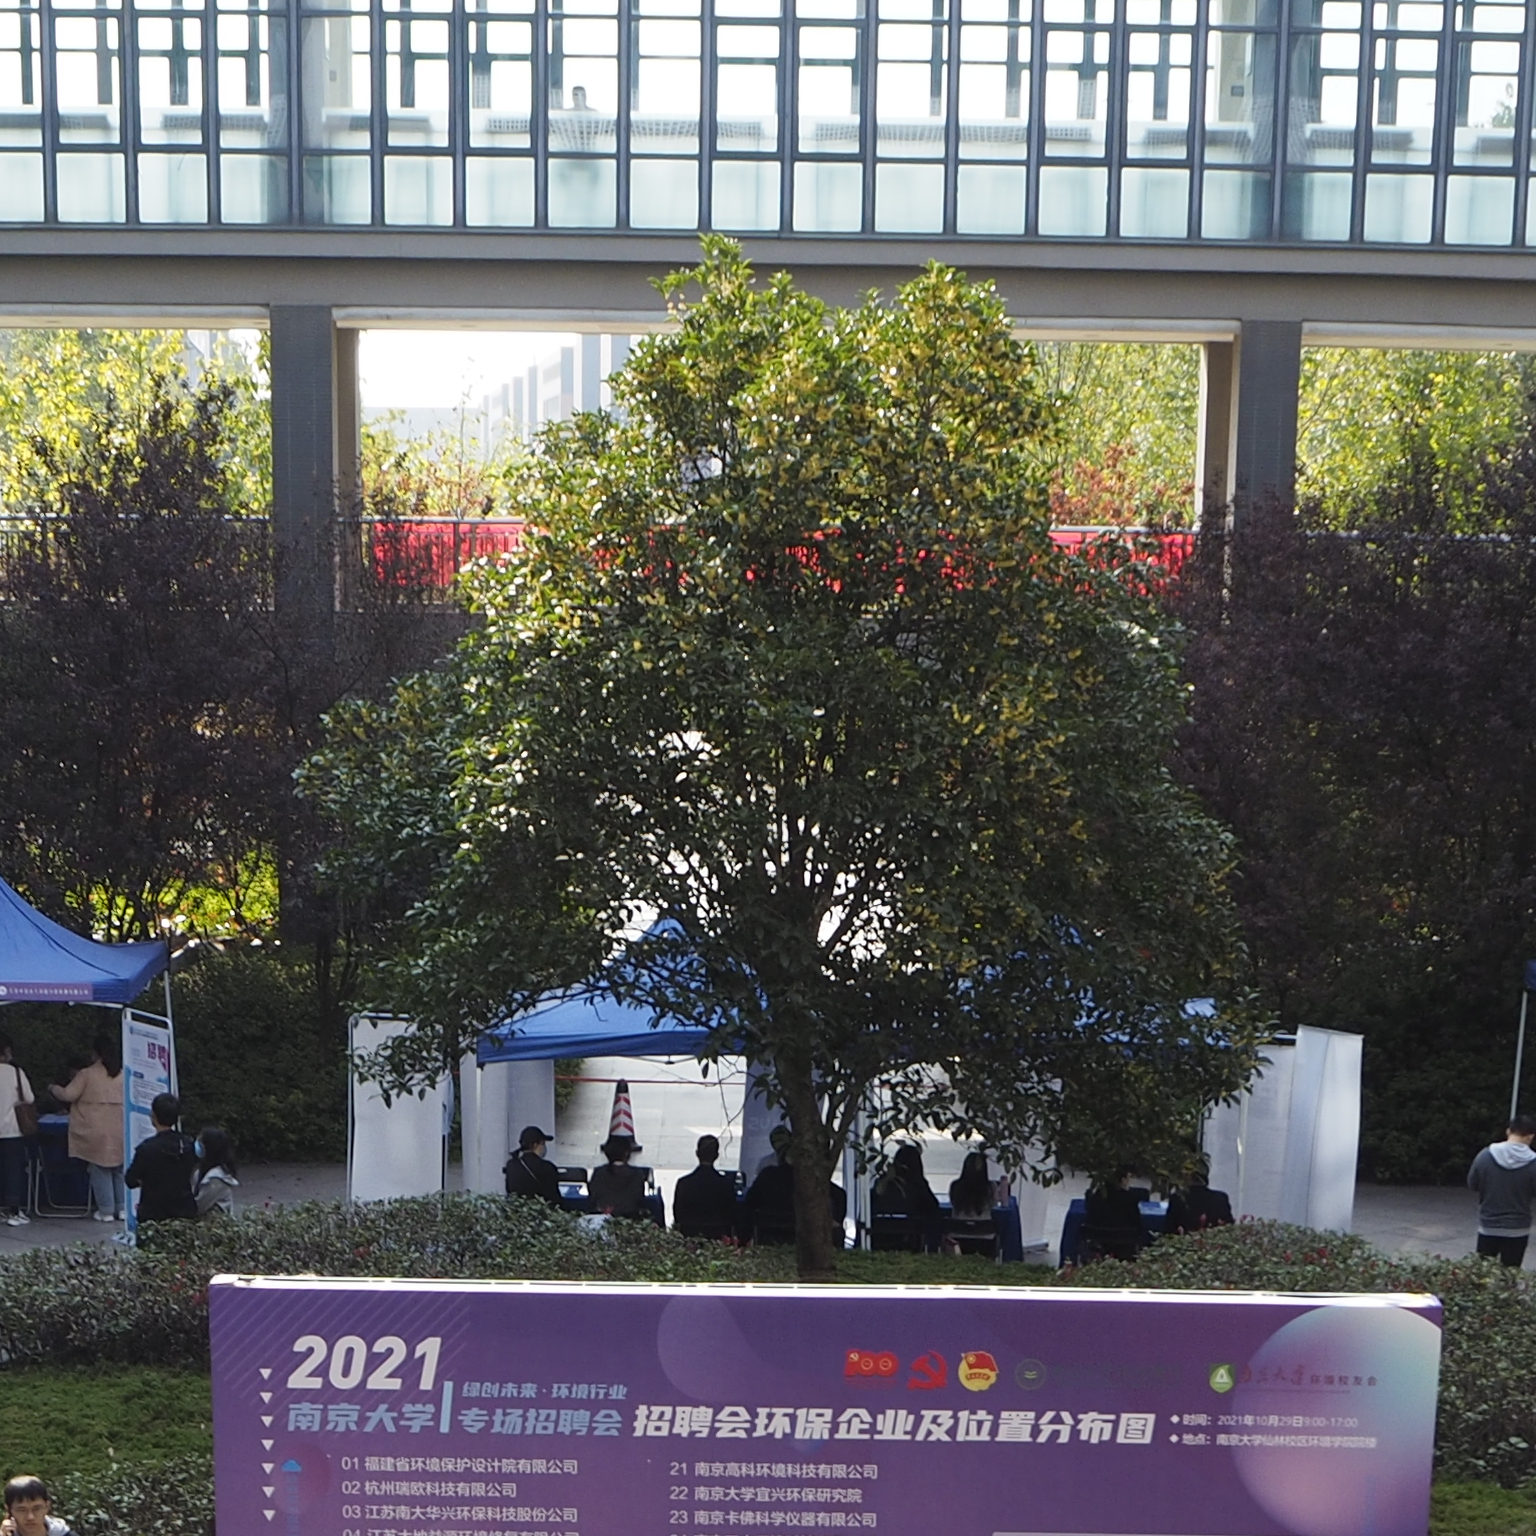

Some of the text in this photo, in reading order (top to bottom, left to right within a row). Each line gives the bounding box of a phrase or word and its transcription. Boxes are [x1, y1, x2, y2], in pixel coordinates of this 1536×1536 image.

[287, 1334, 442, 1391] 2021
[287, 1401, 436, 1433] 南京大学
[457, 1407, 623, 1437] 专场招聘会
[632, 1404, 1157, 1446] 招聘会环保企业及位置分布图
[342, 1456, 578, 1475] 01 福建省环境保护设计院有限公司
[669, 1461, 878, 1480] 21 南京高科环境科技有限公司
[342, 1480, 517, 1498] 02 杭州瑞欧科技有限公司
[669, 1485, 863, 1503] 22 南京大学宜兴环保研究院
[342, 1504, 578, 1523] 03 江苏南大华兴环保科技股份公司
[669, 1510, 878, 1528] 23 南京卡佛科学仪器有限公司
